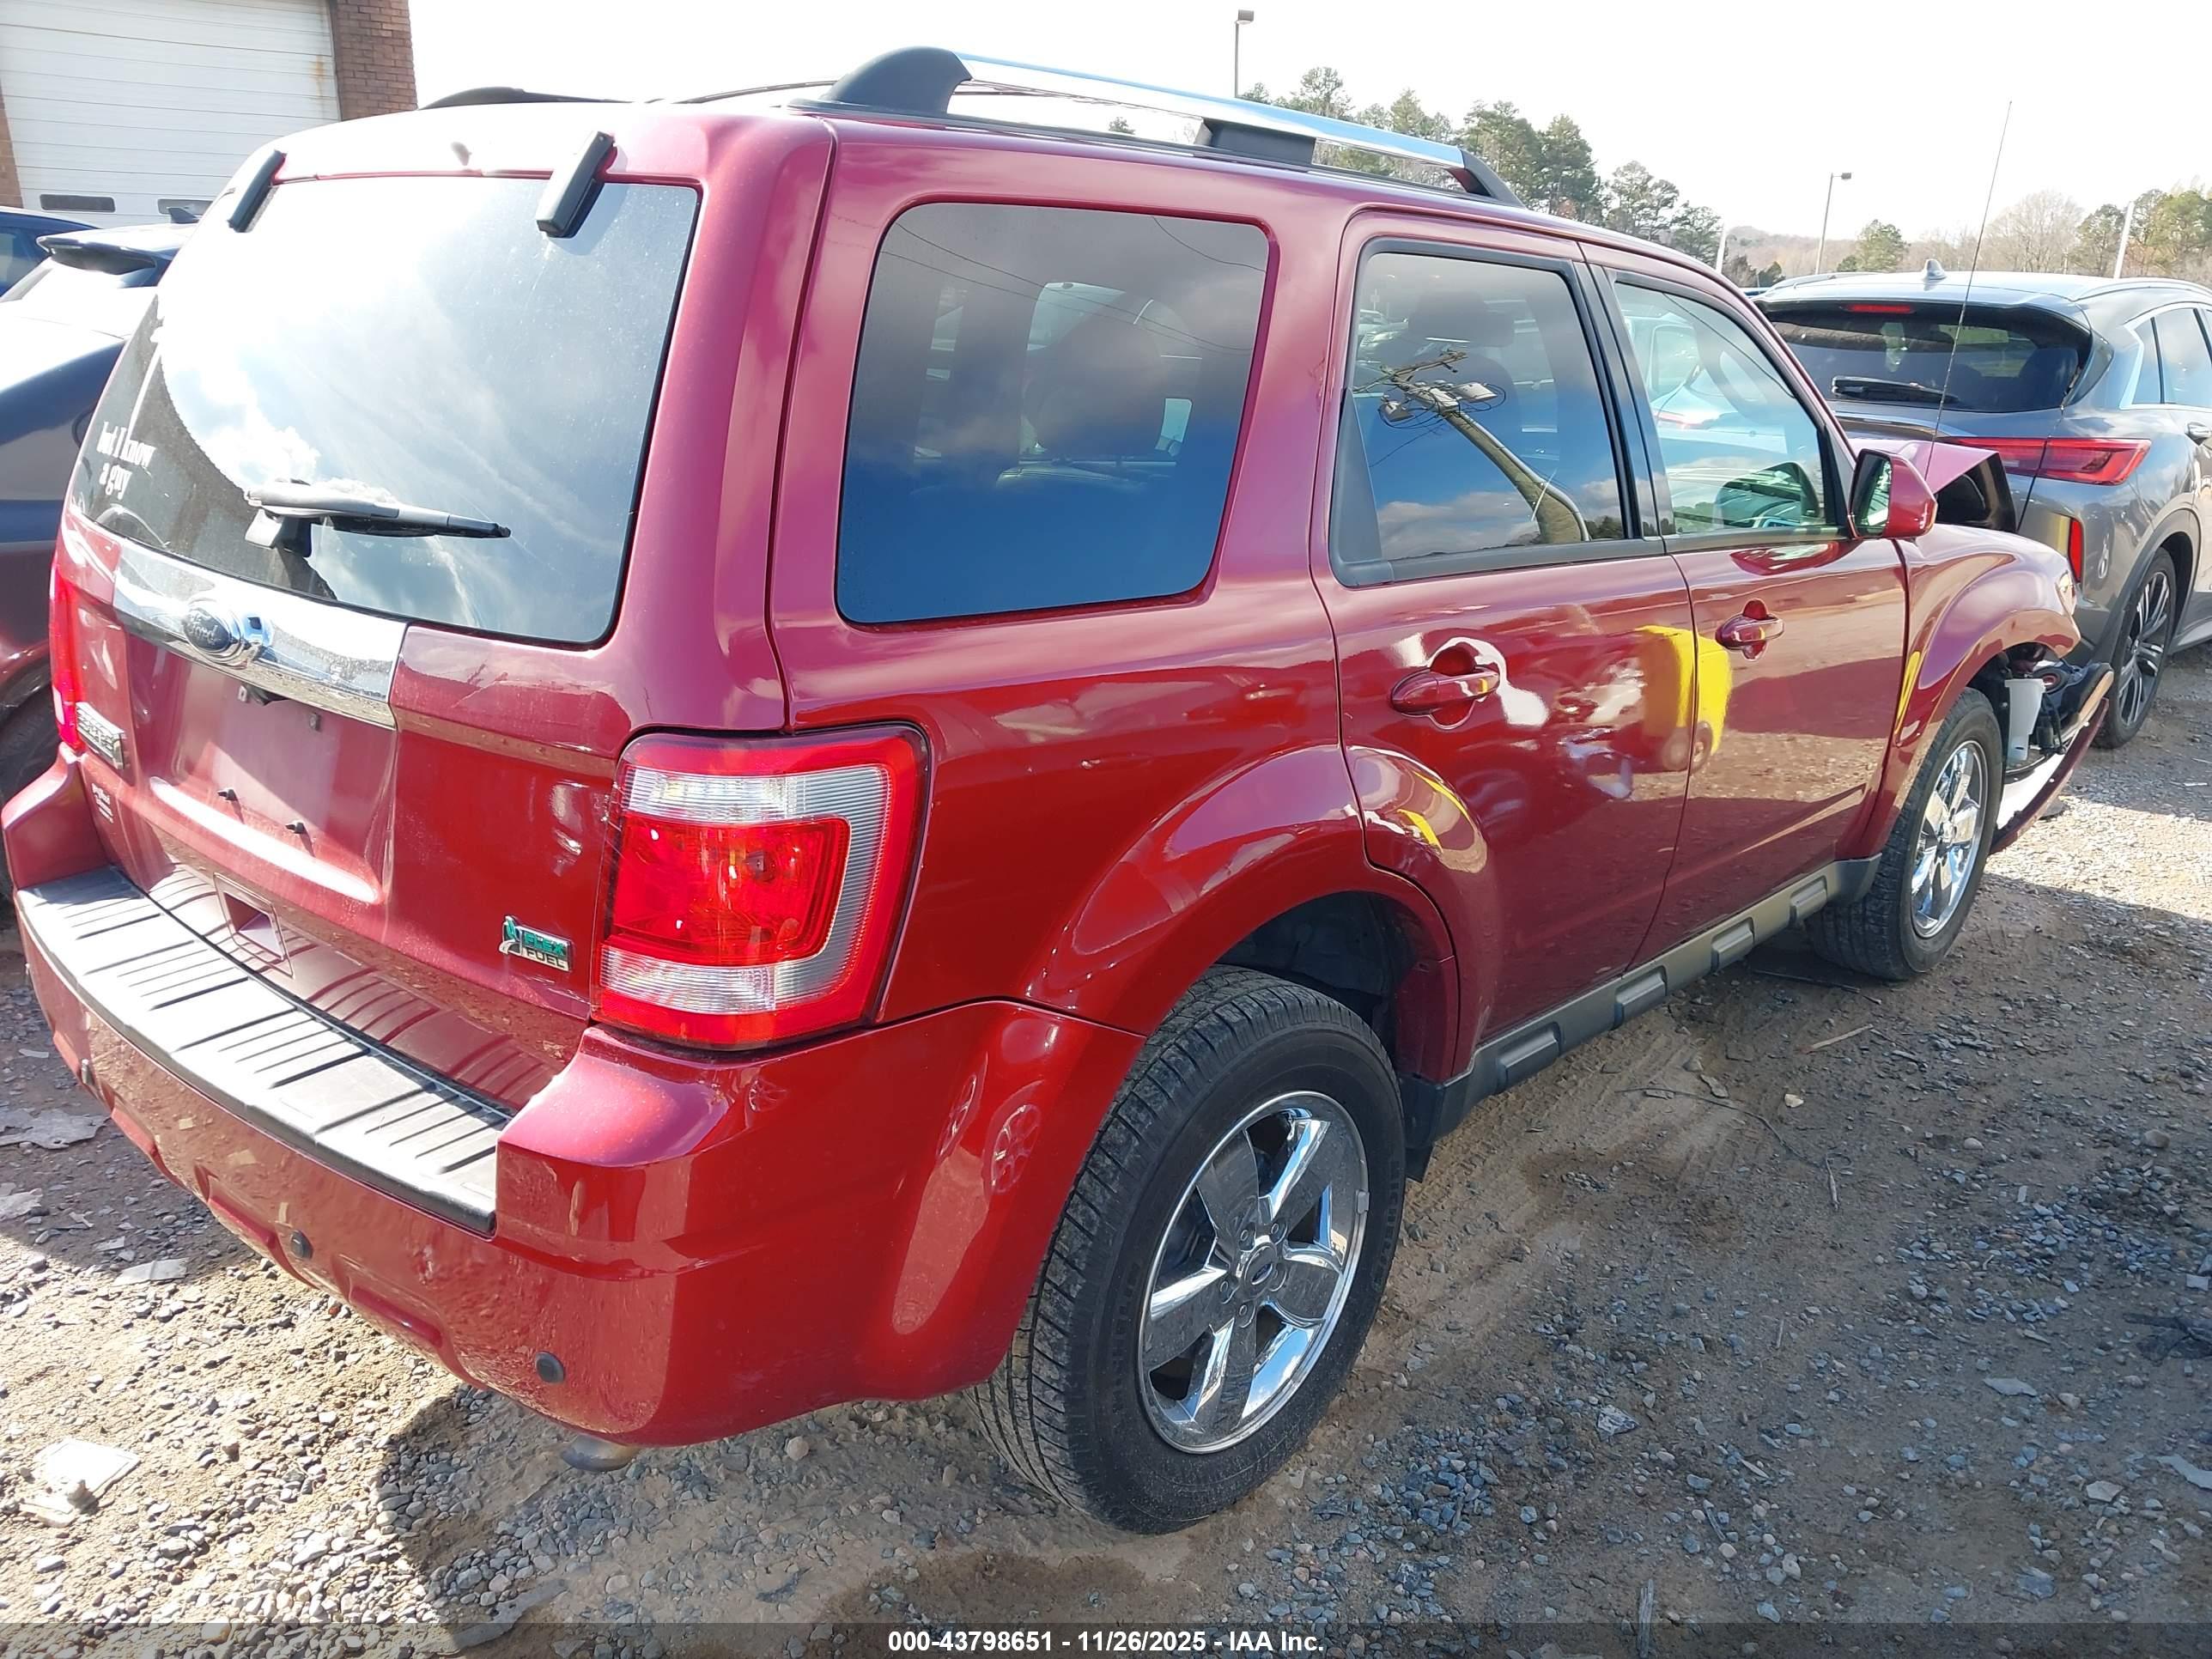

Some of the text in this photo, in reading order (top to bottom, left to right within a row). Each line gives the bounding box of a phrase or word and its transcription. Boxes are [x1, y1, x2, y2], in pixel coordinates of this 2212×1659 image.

[96, 422, 118, 456] but
[119, 427, 156, 468] know
[99, 462, 133, 501] a guy
[185, 612, 218, 647] Ford
[524, 932, 566, 957] FLEX
[525, 947, 567, 969] FUEL
